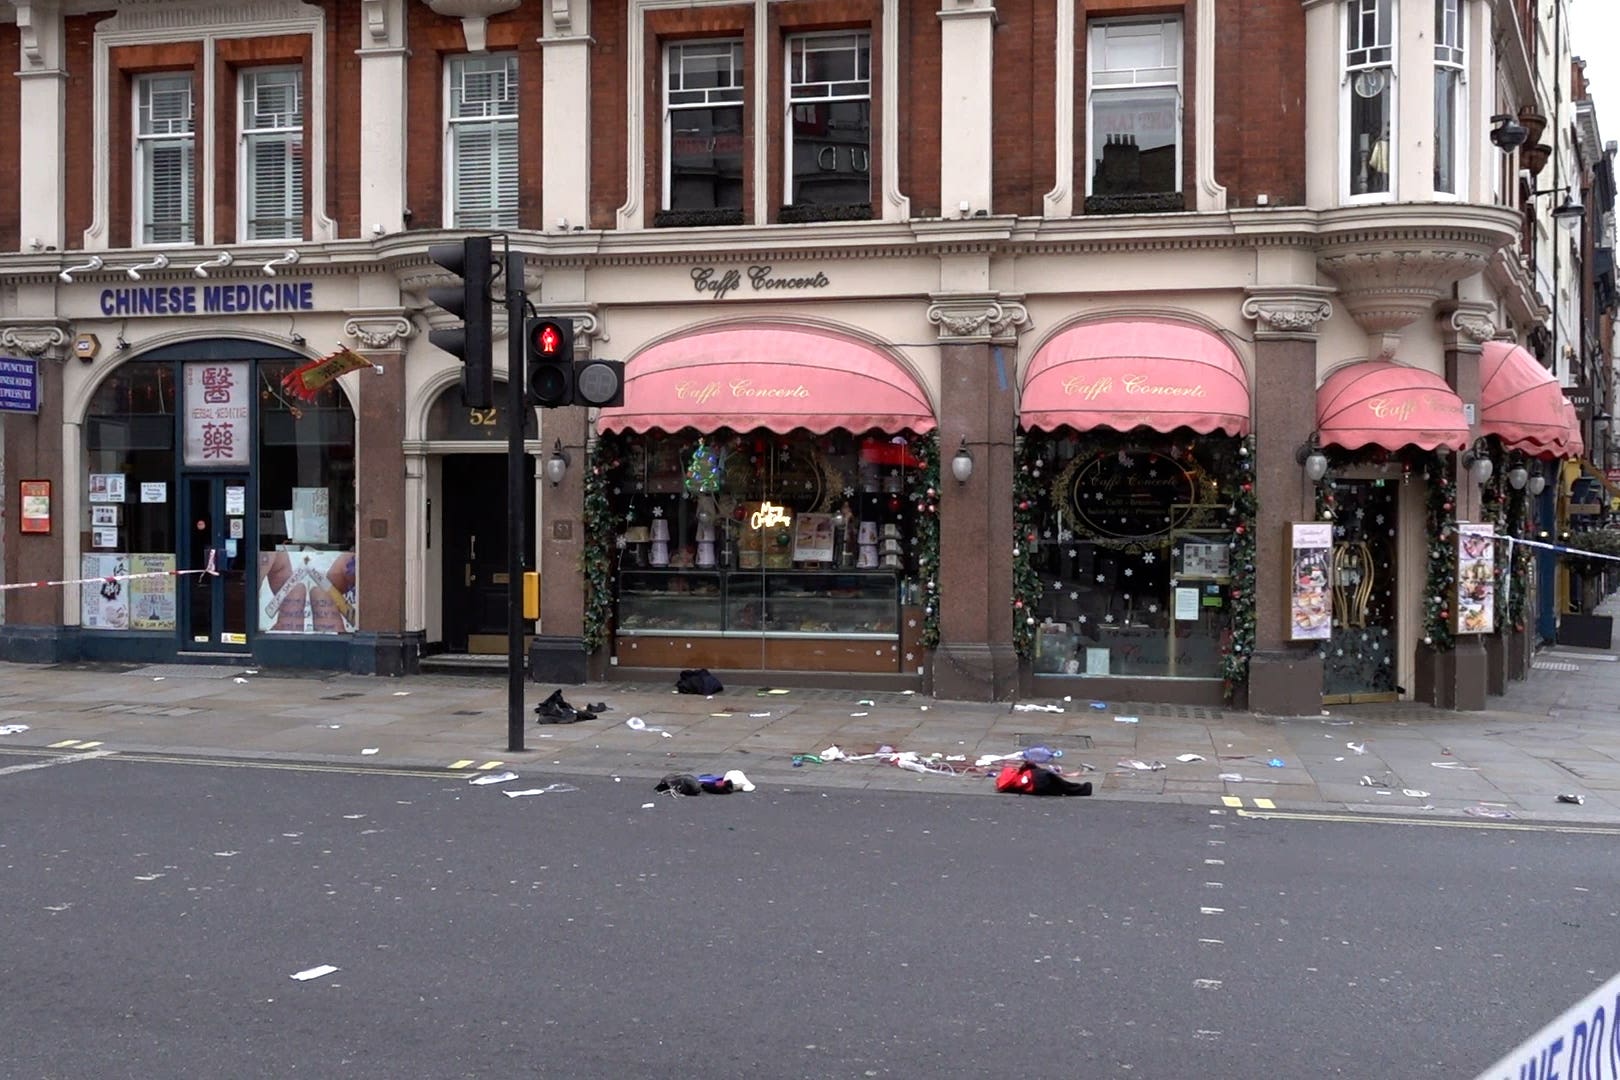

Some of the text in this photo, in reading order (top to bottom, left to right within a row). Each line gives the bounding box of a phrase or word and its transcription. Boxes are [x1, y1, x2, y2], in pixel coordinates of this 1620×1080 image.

[747, 265, 830, 291] Concerto
[101, 282, 313, 315] CHINESE MEDICINE
[728, 376, 810, 398] Concerto
[1120, 374, 1207, 398] Concerto
[469, 408, 496, 425] 52
